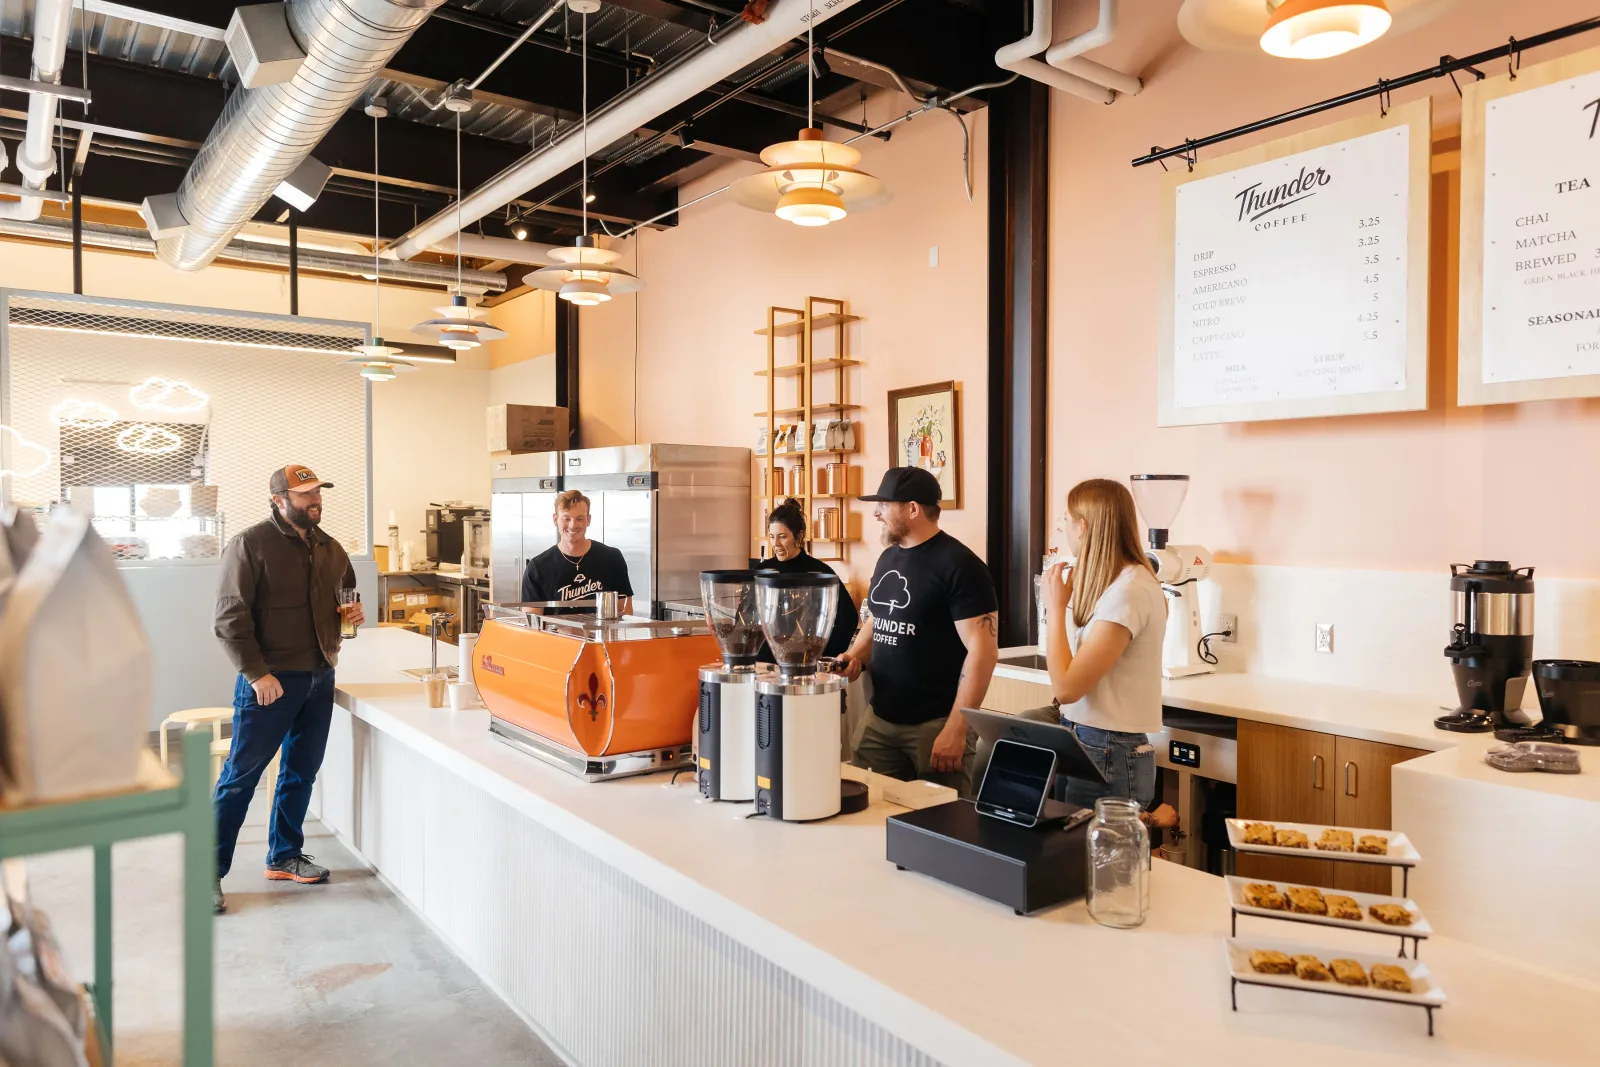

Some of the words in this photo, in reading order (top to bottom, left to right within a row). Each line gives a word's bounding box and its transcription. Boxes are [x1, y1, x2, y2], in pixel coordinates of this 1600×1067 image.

[1555, 178, 1591, 194] TEA
[1234, 166, 1331, 222] Thunder
[1254, 213, 1308, 232] COFFEE
[1358, 216, 1380, 228] 3.25
[1515, 213, 1549, 228] CHAI
[1358, 235, 1380, 248] 3.25
[1515, 230, 1577, 250] MATCHA
[1193, 250, 1214, 262] DRIP
[1364, 254, 1380, 265] 3.5
[1515, 252, 1577, 272] BREWED
[1193, 263, 1237, 278] ESPRESSO
[1364, 273, 1379, 284] 4.5
[1192, 278, 1248, 295] AMERICANO
[1372, 292, 1379, 302] 5
[1192, 300, 1216, 312] COLD
[1219, 296, 1247, 308] BREW
[1192, 316, 1220, 328] NITRO
[1356, 312, 1379, 322] 4.25
[1576, 341, 1600, 352] FOR
[1313, 353, 1346, 363] SYRUP
[1225, 364, 1248, 373] MILK
[557, 579, 602, 601] Thunder
[873, 632, 898, 646] COFFEE
